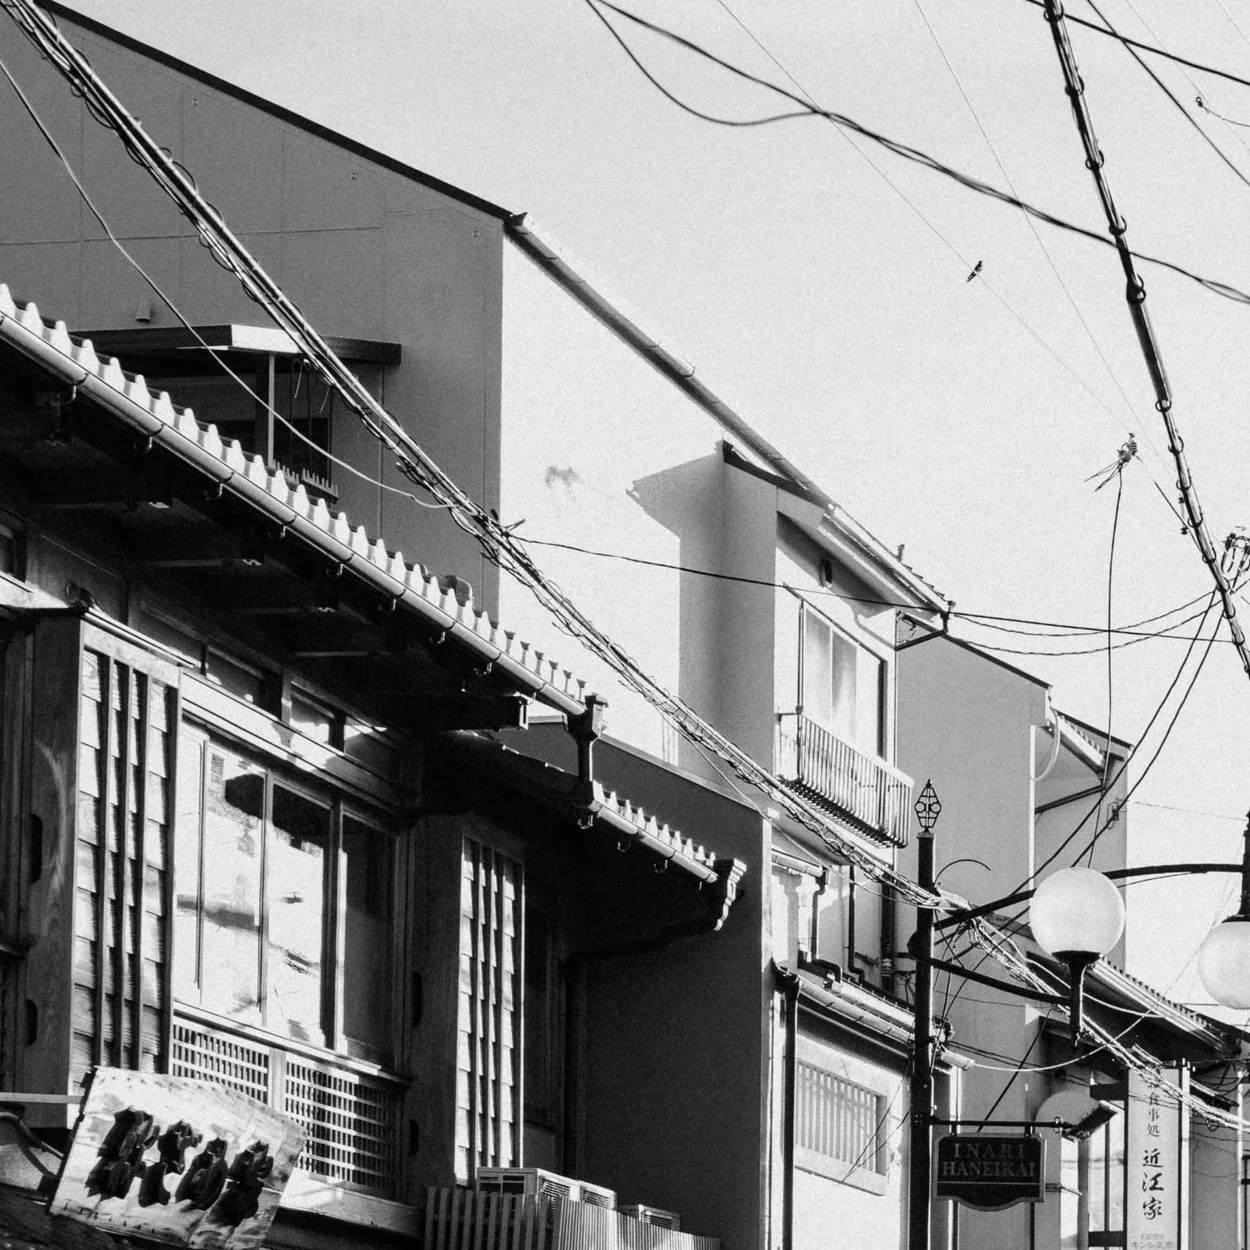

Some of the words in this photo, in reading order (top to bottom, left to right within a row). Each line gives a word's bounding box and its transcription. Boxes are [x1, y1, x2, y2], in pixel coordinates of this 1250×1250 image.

[953, 1143, 1025, 1158] INARI
[942, 1161, 1036, 1177] HANEIKAI
[1141, 1148, 1165, 1220] 近江家
